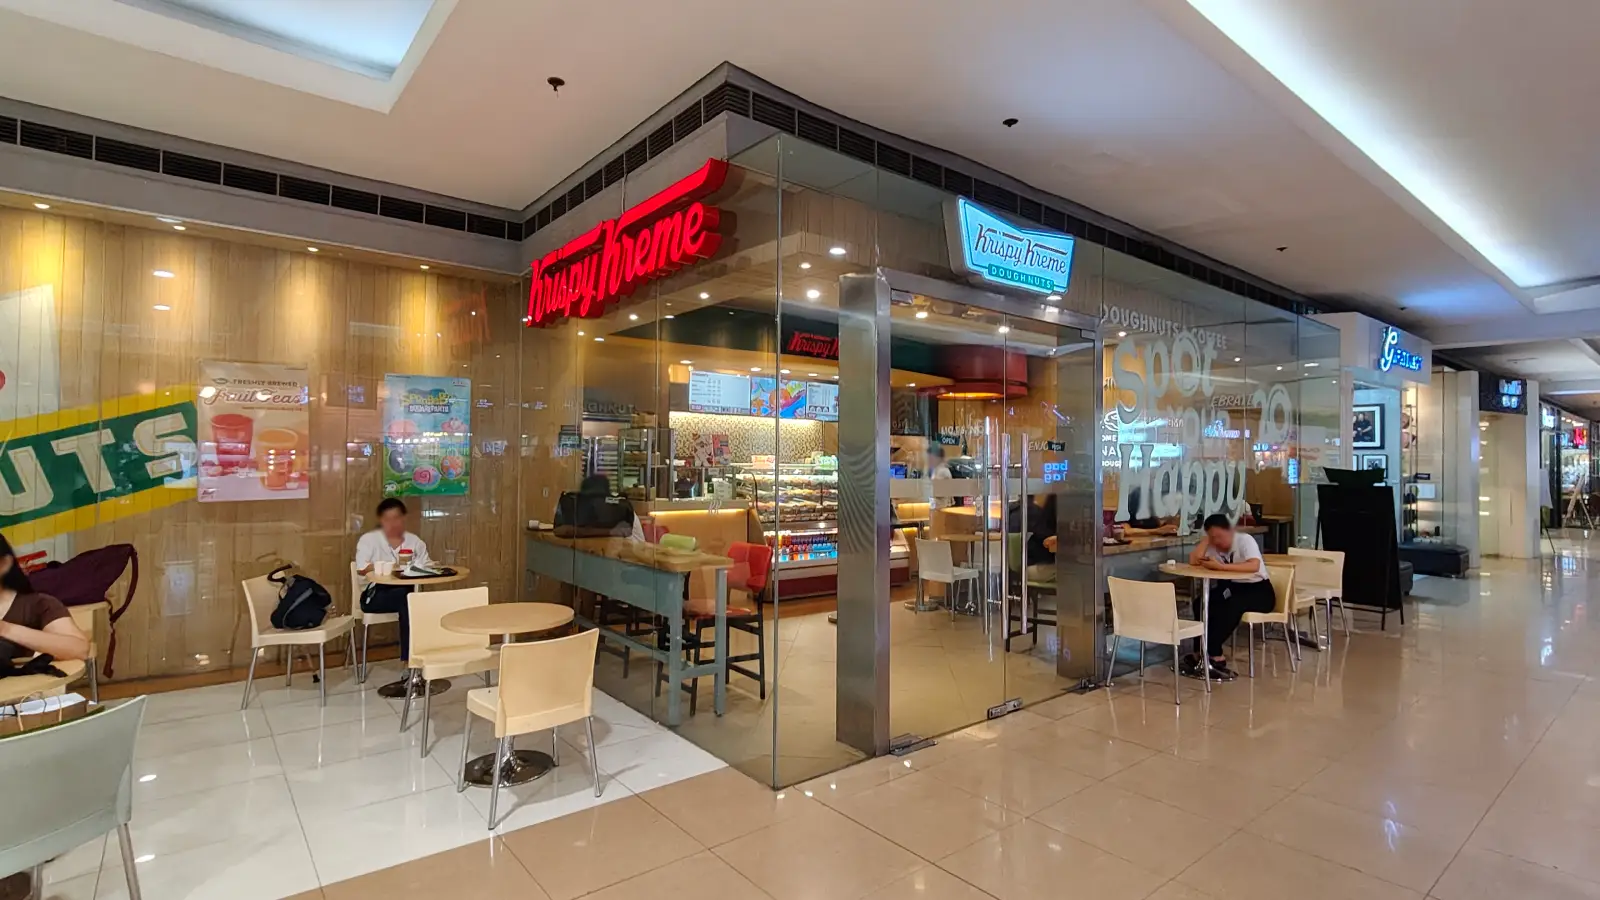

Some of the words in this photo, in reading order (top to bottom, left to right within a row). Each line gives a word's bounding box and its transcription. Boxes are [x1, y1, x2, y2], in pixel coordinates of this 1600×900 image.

[526, 222, 604, 328] Krispy
[597, 158, 727, 303] Kreme
[974, 223, 1024, 267] Krispy
[1022, 238, 1068, 274] Kreme
[991, 265, 1052, 289] DOUGHNUTS
[788, 331, 831, 357] Krispy
[1113, 330, 1218, 425] Spot
[1114, 443, 1247, 537] Happy
